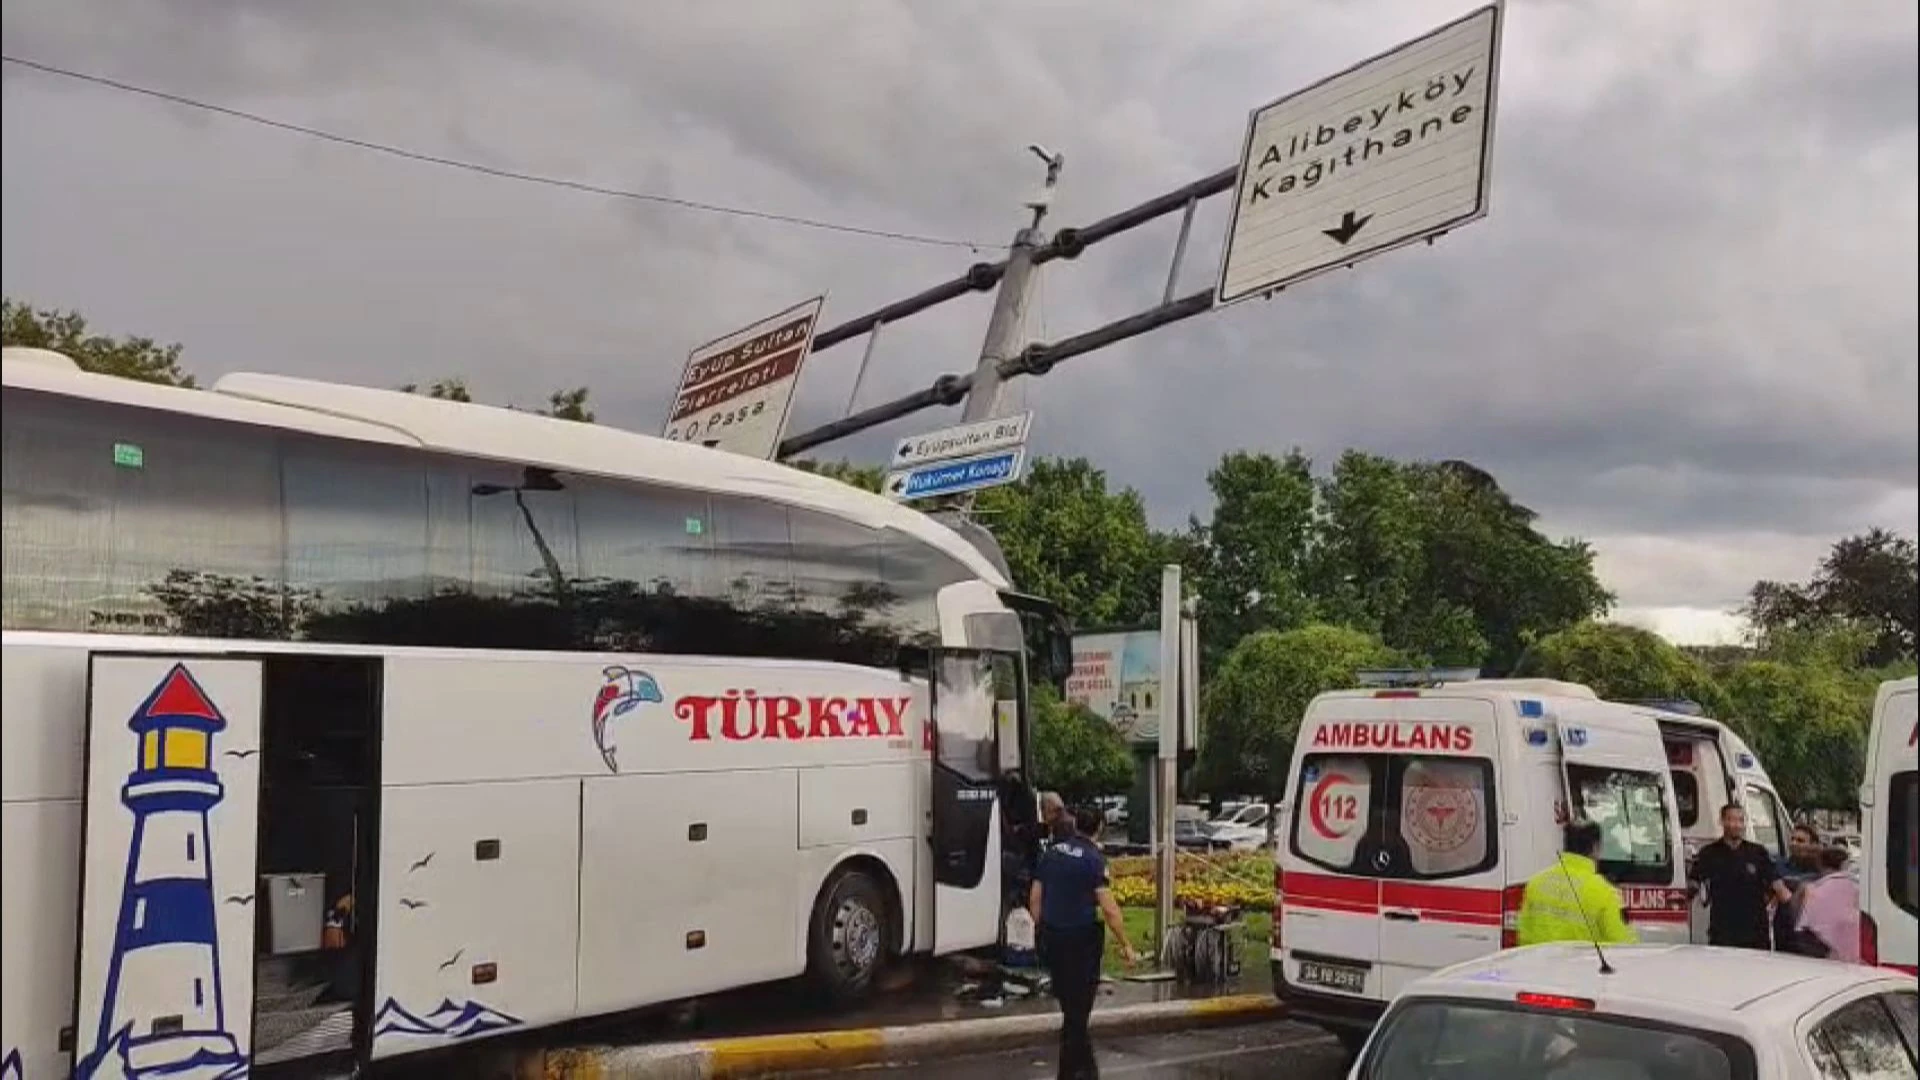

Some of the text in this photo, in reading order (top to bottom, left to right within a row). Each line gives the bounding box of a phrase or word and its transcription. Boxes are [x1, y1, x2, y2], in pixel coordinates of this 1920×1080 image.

[1258, 66, 1475, 170] Alibeyköy
[1251, 104, 1472, 204] Kağıthane
[740, 322, 809, 360] Sultan
[674, 688, 912, 741] TÜRKAY
[1312, 723, 1474, 751] AMBULANS
[1322, 795, 1357, 820] 112
